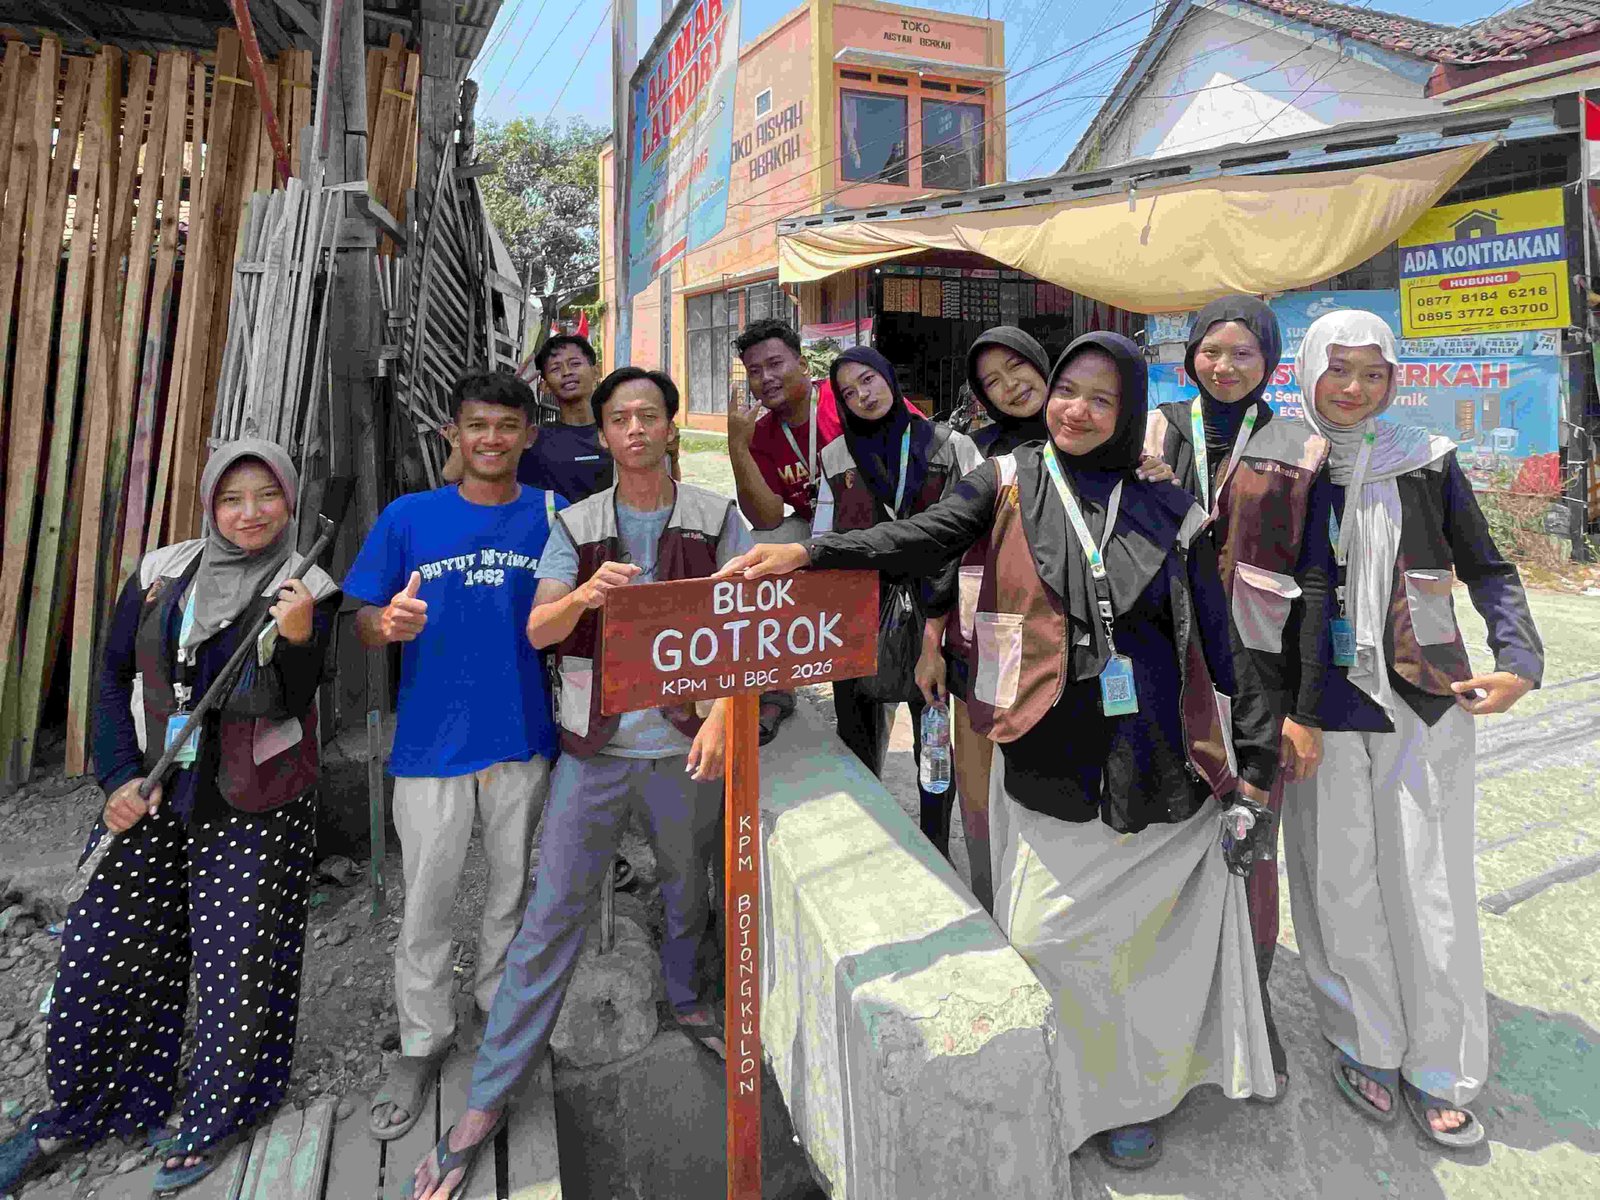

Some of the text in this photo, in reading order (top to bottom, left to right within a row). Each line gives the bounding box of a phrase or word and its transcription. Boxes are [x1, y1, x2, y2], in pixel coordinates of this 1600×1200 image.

[900, 19, 931, 34] TOKO
[883, 32, 951, 50] AISYAH BERKAH
[641, 13, 728, 164] LAUNDRY
[731, 100, 803, 165] OKO AISYAH
[1404, 232, 1560, 273] ADA KONTRAKAN
[1450, 274, 1508, 288] HUBUNGI
[1417, 286, 1548, 307] 0877 8184 6218
[1418, 302, 1549, 322] 0895 3772 63700
[1444, 340, 1476, 348] FRESH
[1396, 362, 1510, 388] ERKAH
[419, 553, 477, 581] BUYUT
[713, 578, 796, 615] BLOK
[662, 658, 833, 696] KPM UI BBC 2026
[737, 815, 753, 873] KPM
